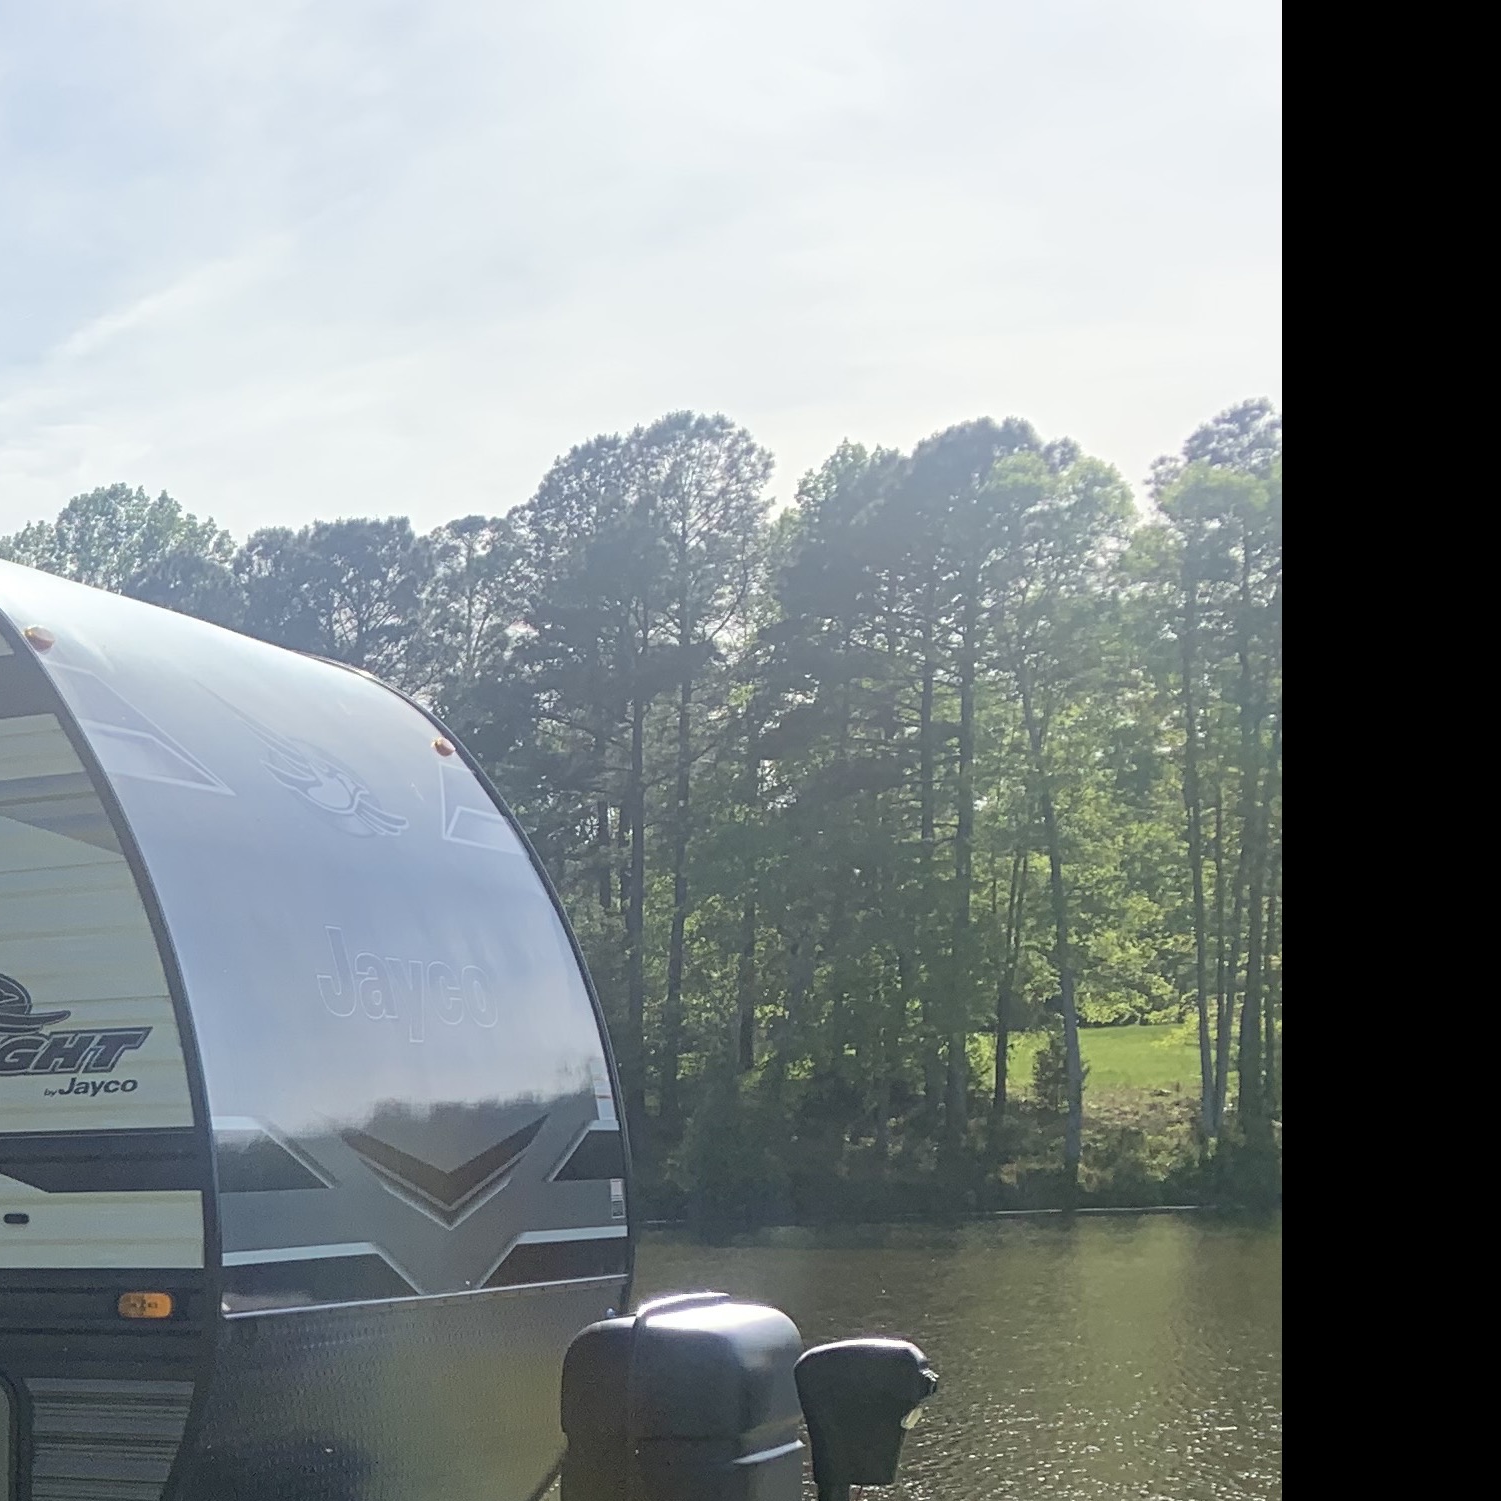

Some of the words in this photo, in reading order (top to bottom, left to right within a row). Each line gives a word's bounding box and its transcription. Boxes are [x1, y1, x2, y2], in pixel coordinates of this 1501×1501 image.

[316, 925, 498, 1043] Jayco
[44, 1088, 58, 1097] by
[58, 1077, 138, 1097] Jayco
